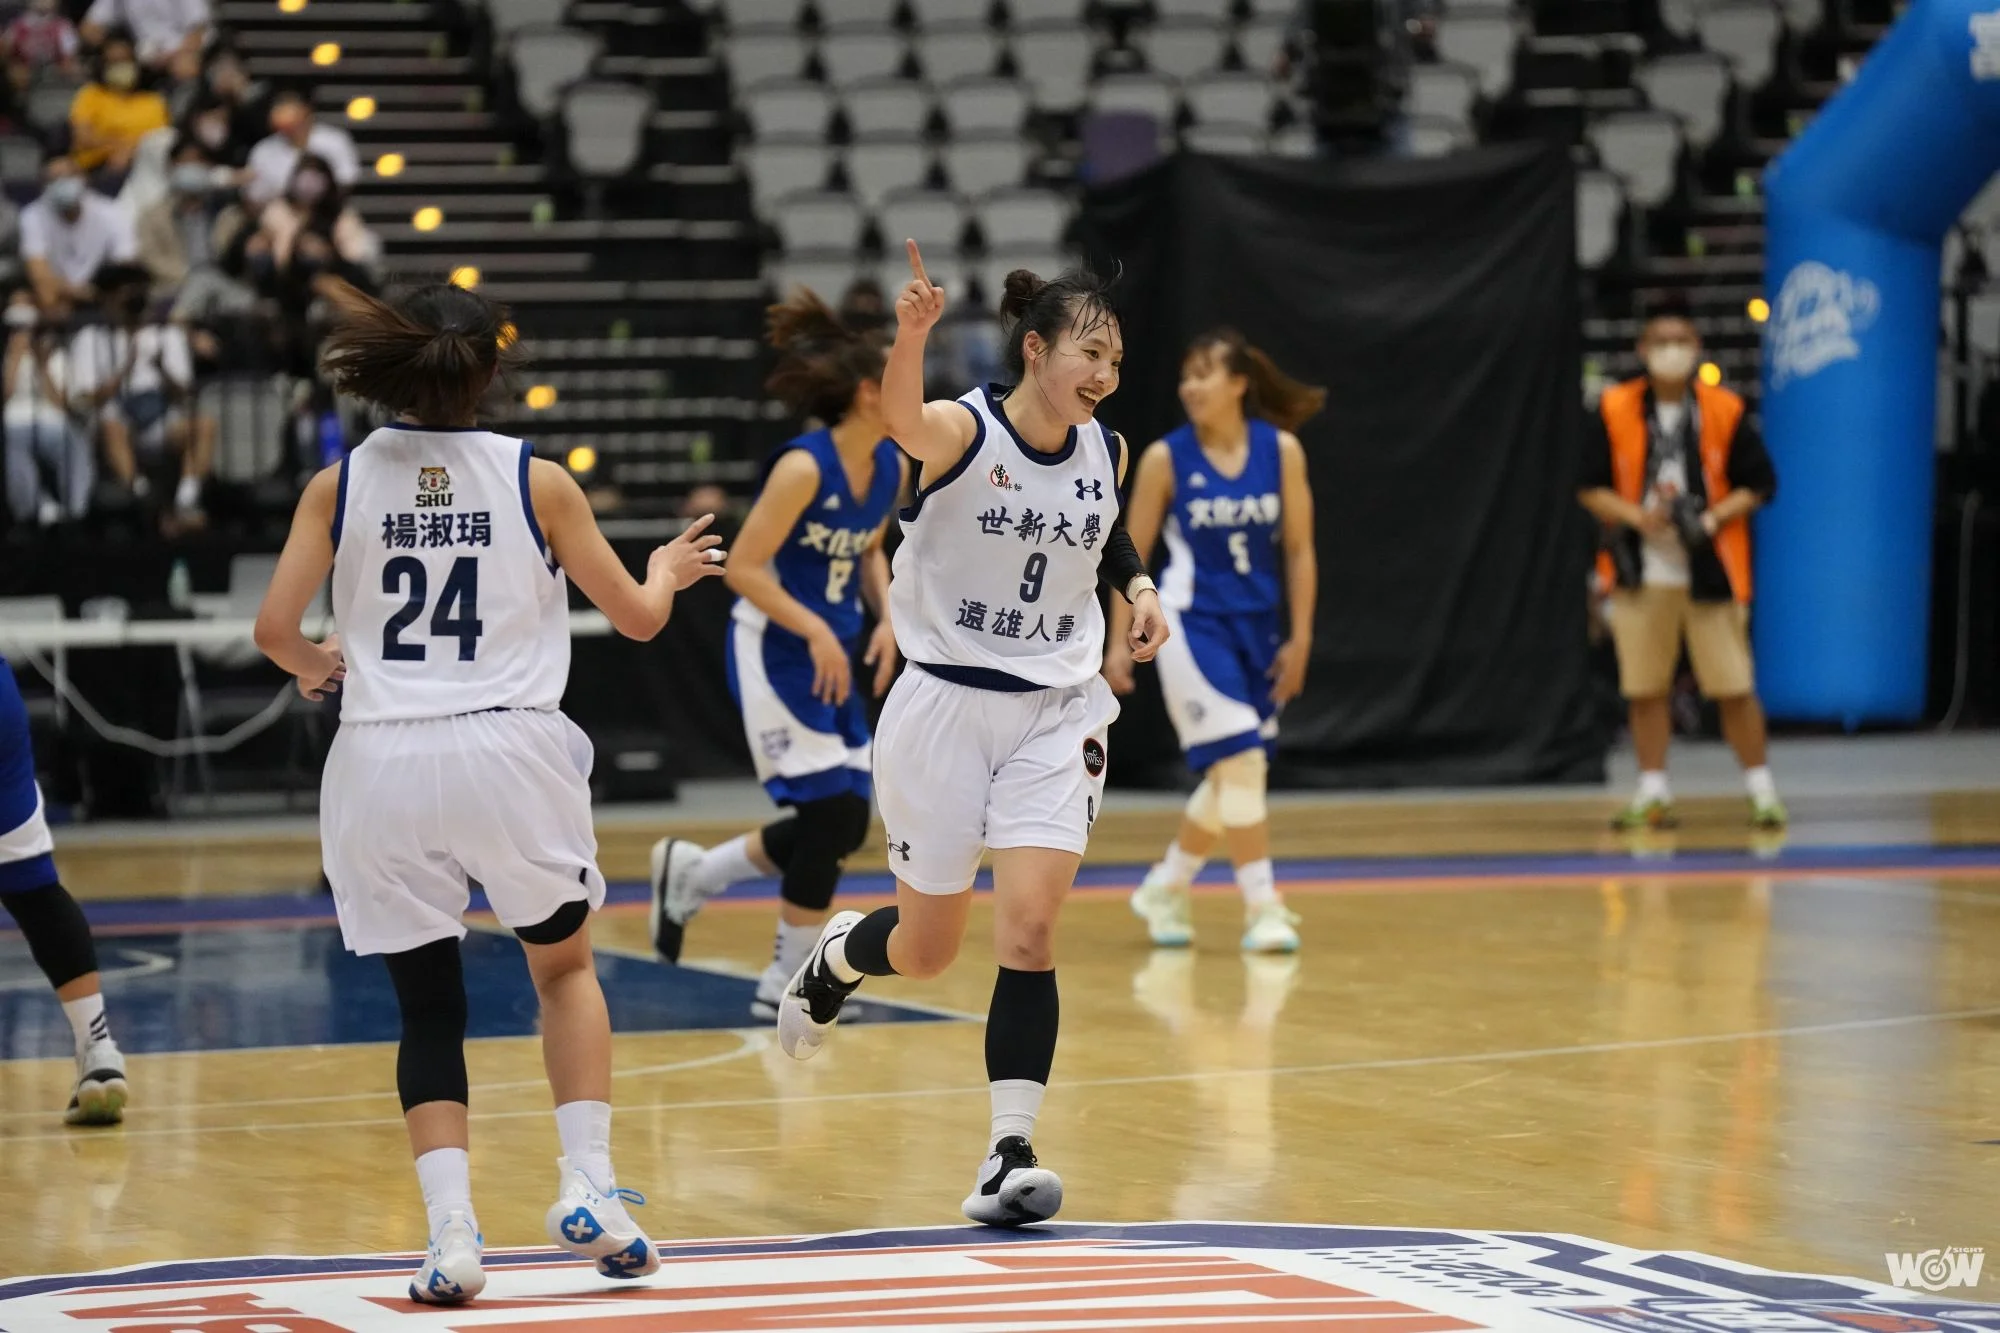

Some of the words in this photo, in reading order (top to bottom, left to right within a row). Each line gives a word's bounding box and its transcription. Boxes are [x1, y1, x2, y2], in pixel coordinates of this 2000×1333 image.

[415, 493, 454, 507] SHU
[381, 511, 491, 549] 楊淑琄
[977, 505, 1101, 550] 世新大學
[1019, 552, 1048, 603] 9
[382, 556, 483, 661] 24
[956, 598, 1075, 642] 遠雄人壽
[1409, 1262, 1605, 1298] 2022
